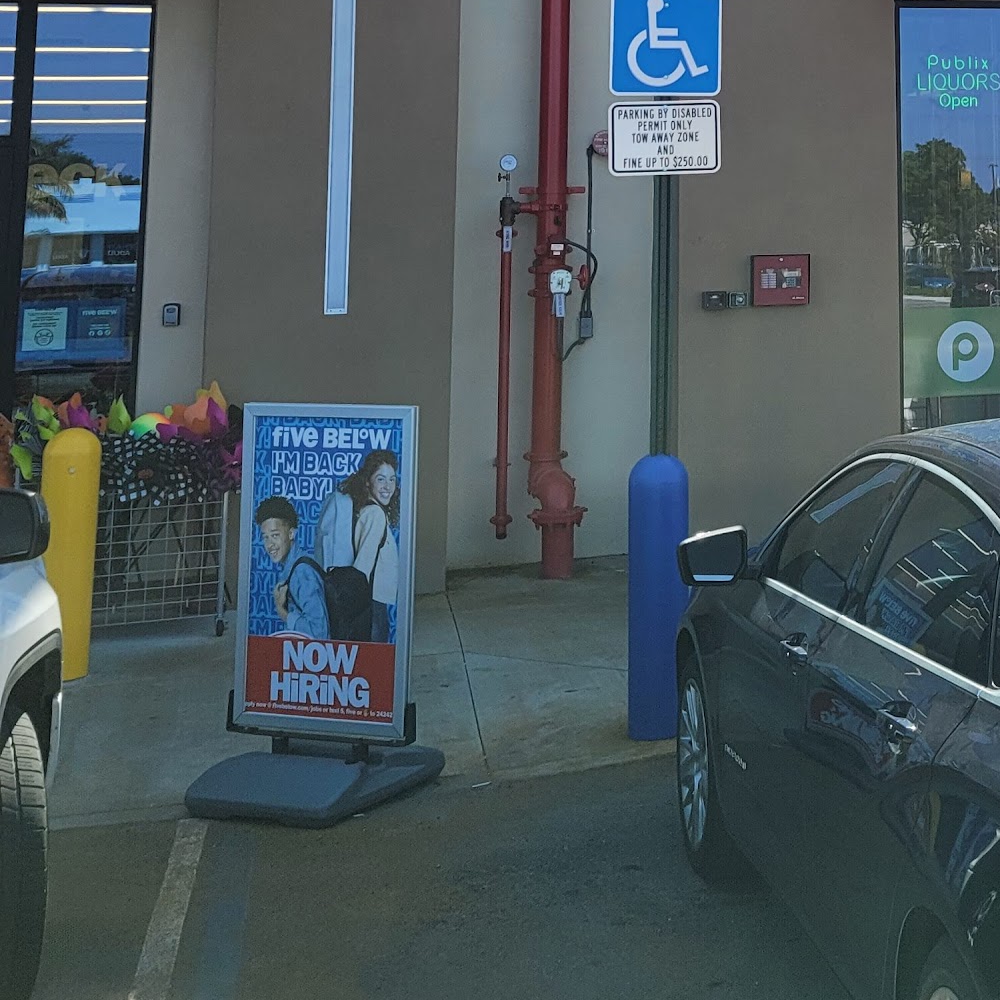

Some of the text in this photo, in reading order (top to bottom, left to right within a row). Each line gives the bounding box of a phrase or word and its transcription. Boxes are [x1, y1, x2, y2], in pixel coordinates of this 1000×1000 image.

[927, 54, 988, 70] Publix
[917, 72, 1000, 91] LIQUORS
[939, 93, 978, 110] Open
[618, 107, 712, 120] PARKING BY DISABLED
[637, 119, 693, 131] PERMIT ONLY
[631, 131, 700, 144] TOW AWAY ZONE
[657, 145, 675, 155] AND
[623, 155, 708, 169] FINE UP TO $250.00
[271, 450, 362, 476] I'M BACK
[270, 476, 332, 501] BABY!
[282, 640, 359, 675] NOW
